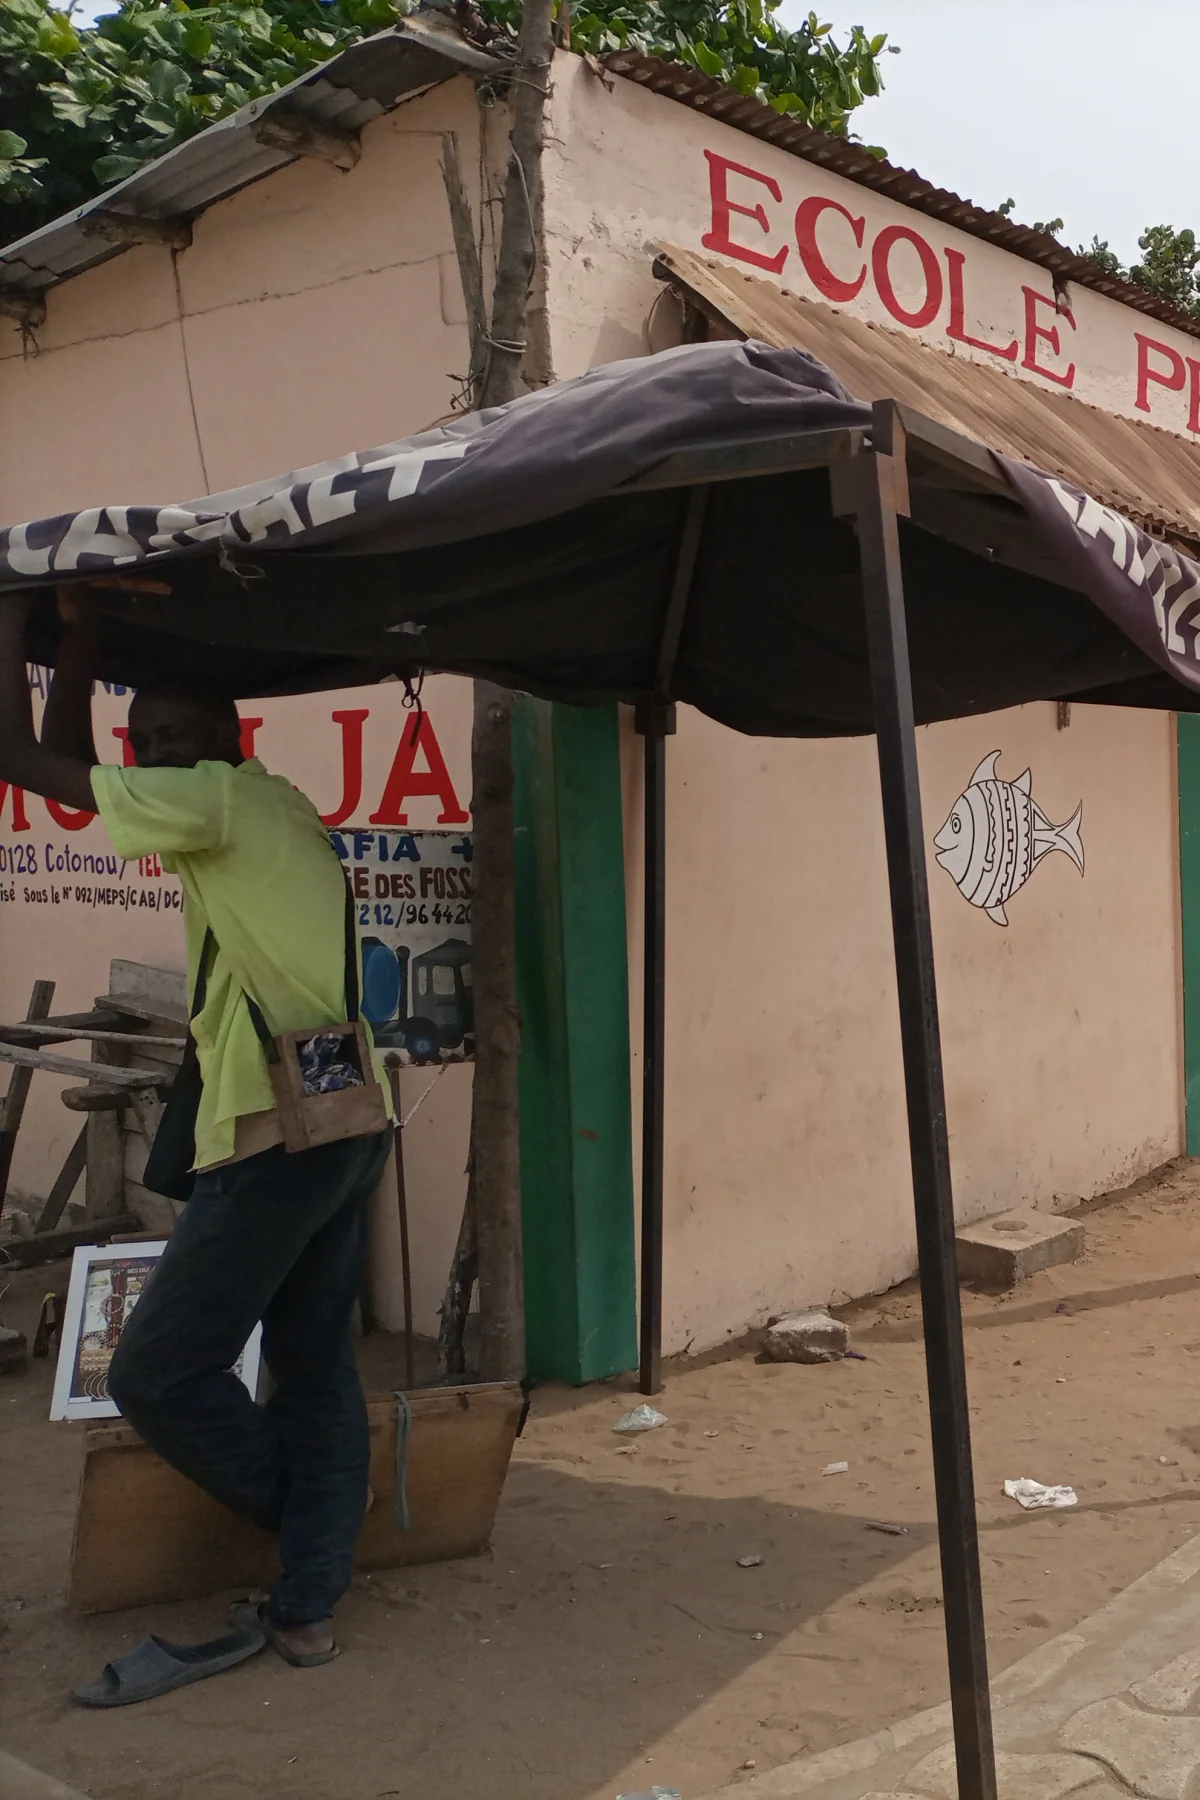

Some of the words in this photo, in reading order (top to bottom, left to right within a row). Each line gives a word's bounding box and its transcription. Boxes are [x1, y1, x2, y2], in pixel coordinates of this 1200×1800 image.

[701, 149, 1077, 389] ECOLE
[24, 887, 48, 903] Sous
[51, 885, 60, 904] le
[375, 873, 416, 899] DES
[420, 867, 473, 899] FOSS
